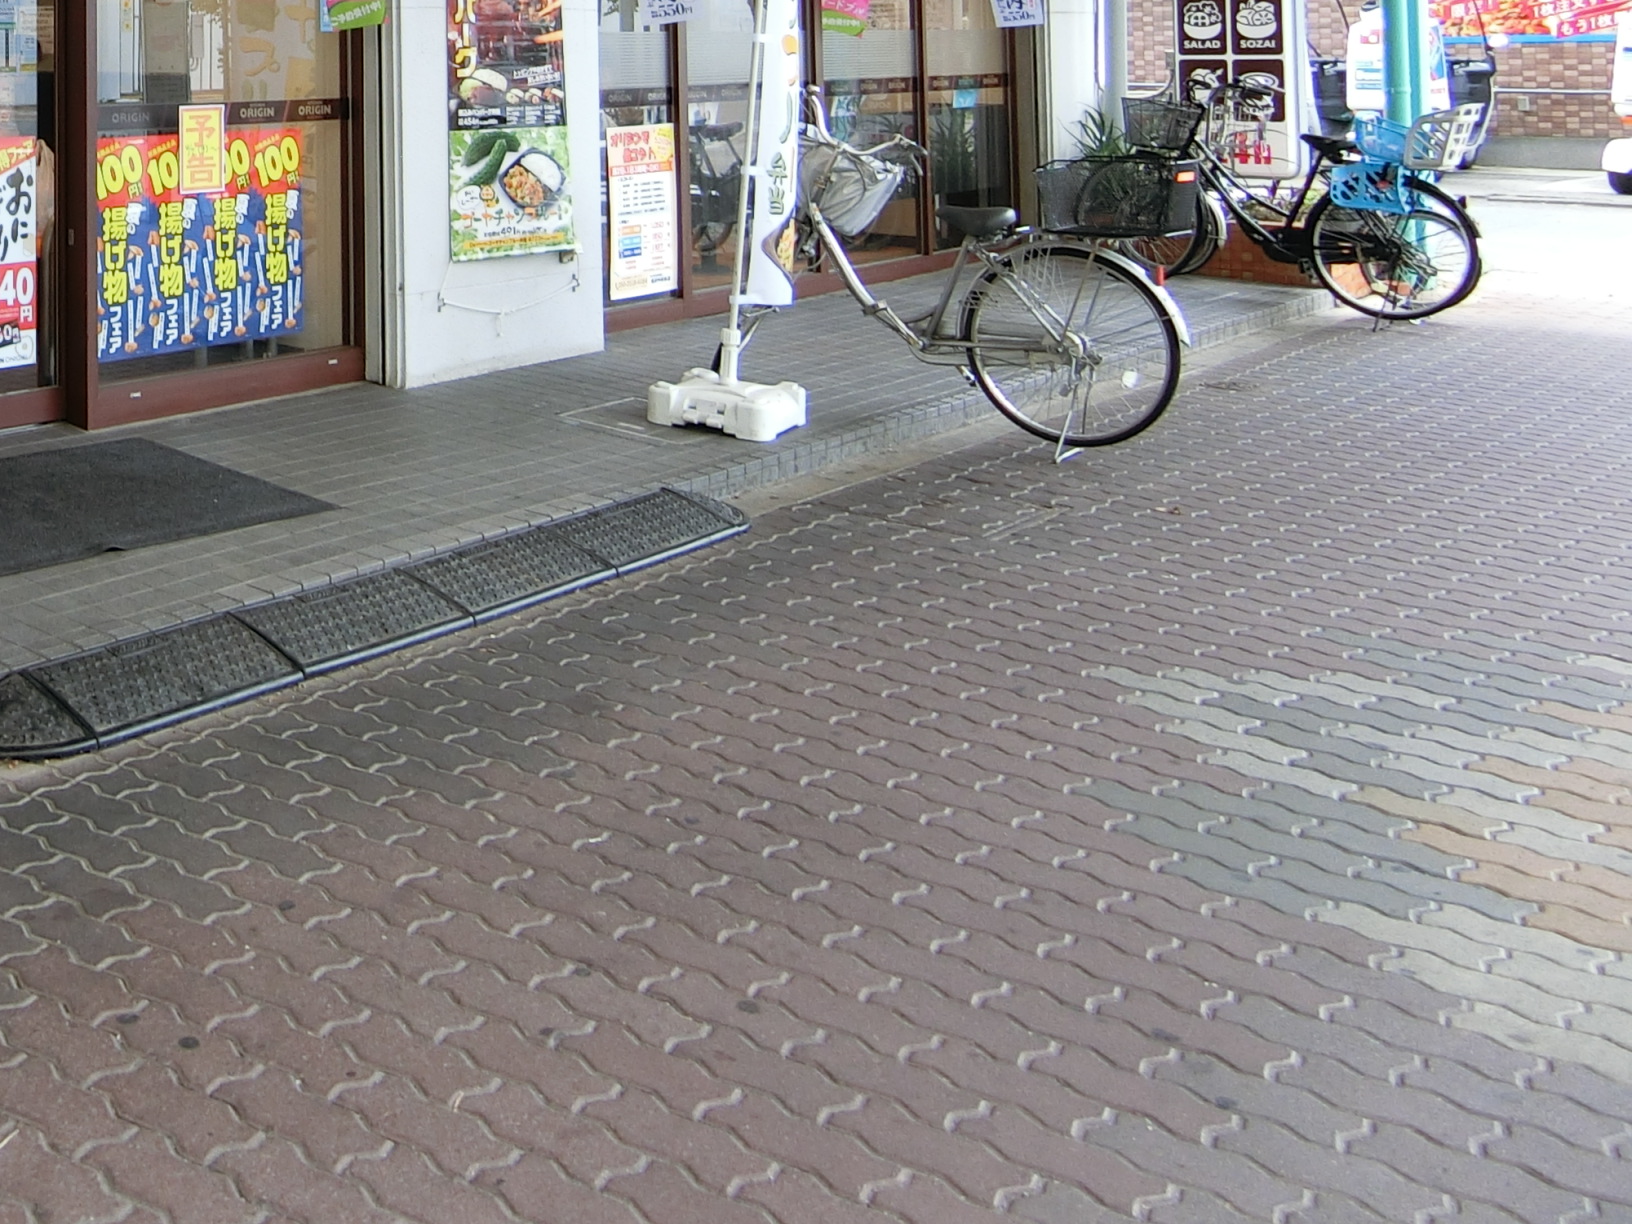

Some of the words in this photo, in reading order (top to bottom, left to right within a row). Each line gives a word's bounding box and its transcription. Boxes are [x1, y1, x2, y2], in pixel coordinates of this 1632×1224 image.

[1561, 12, 1618, 36] もう1枚
[1183, 39, 1221, 50] SALAD
[1239, 39, 1276, 50] SOZAI
[239, 107, 275, 119] ORIGIN
[298, 105, 332, 117] ORIGIN
[112, 112, 150, 124] ORIGIN
[185, 113, 217, 185] 予告
[147, 149, 179, 196] 10
